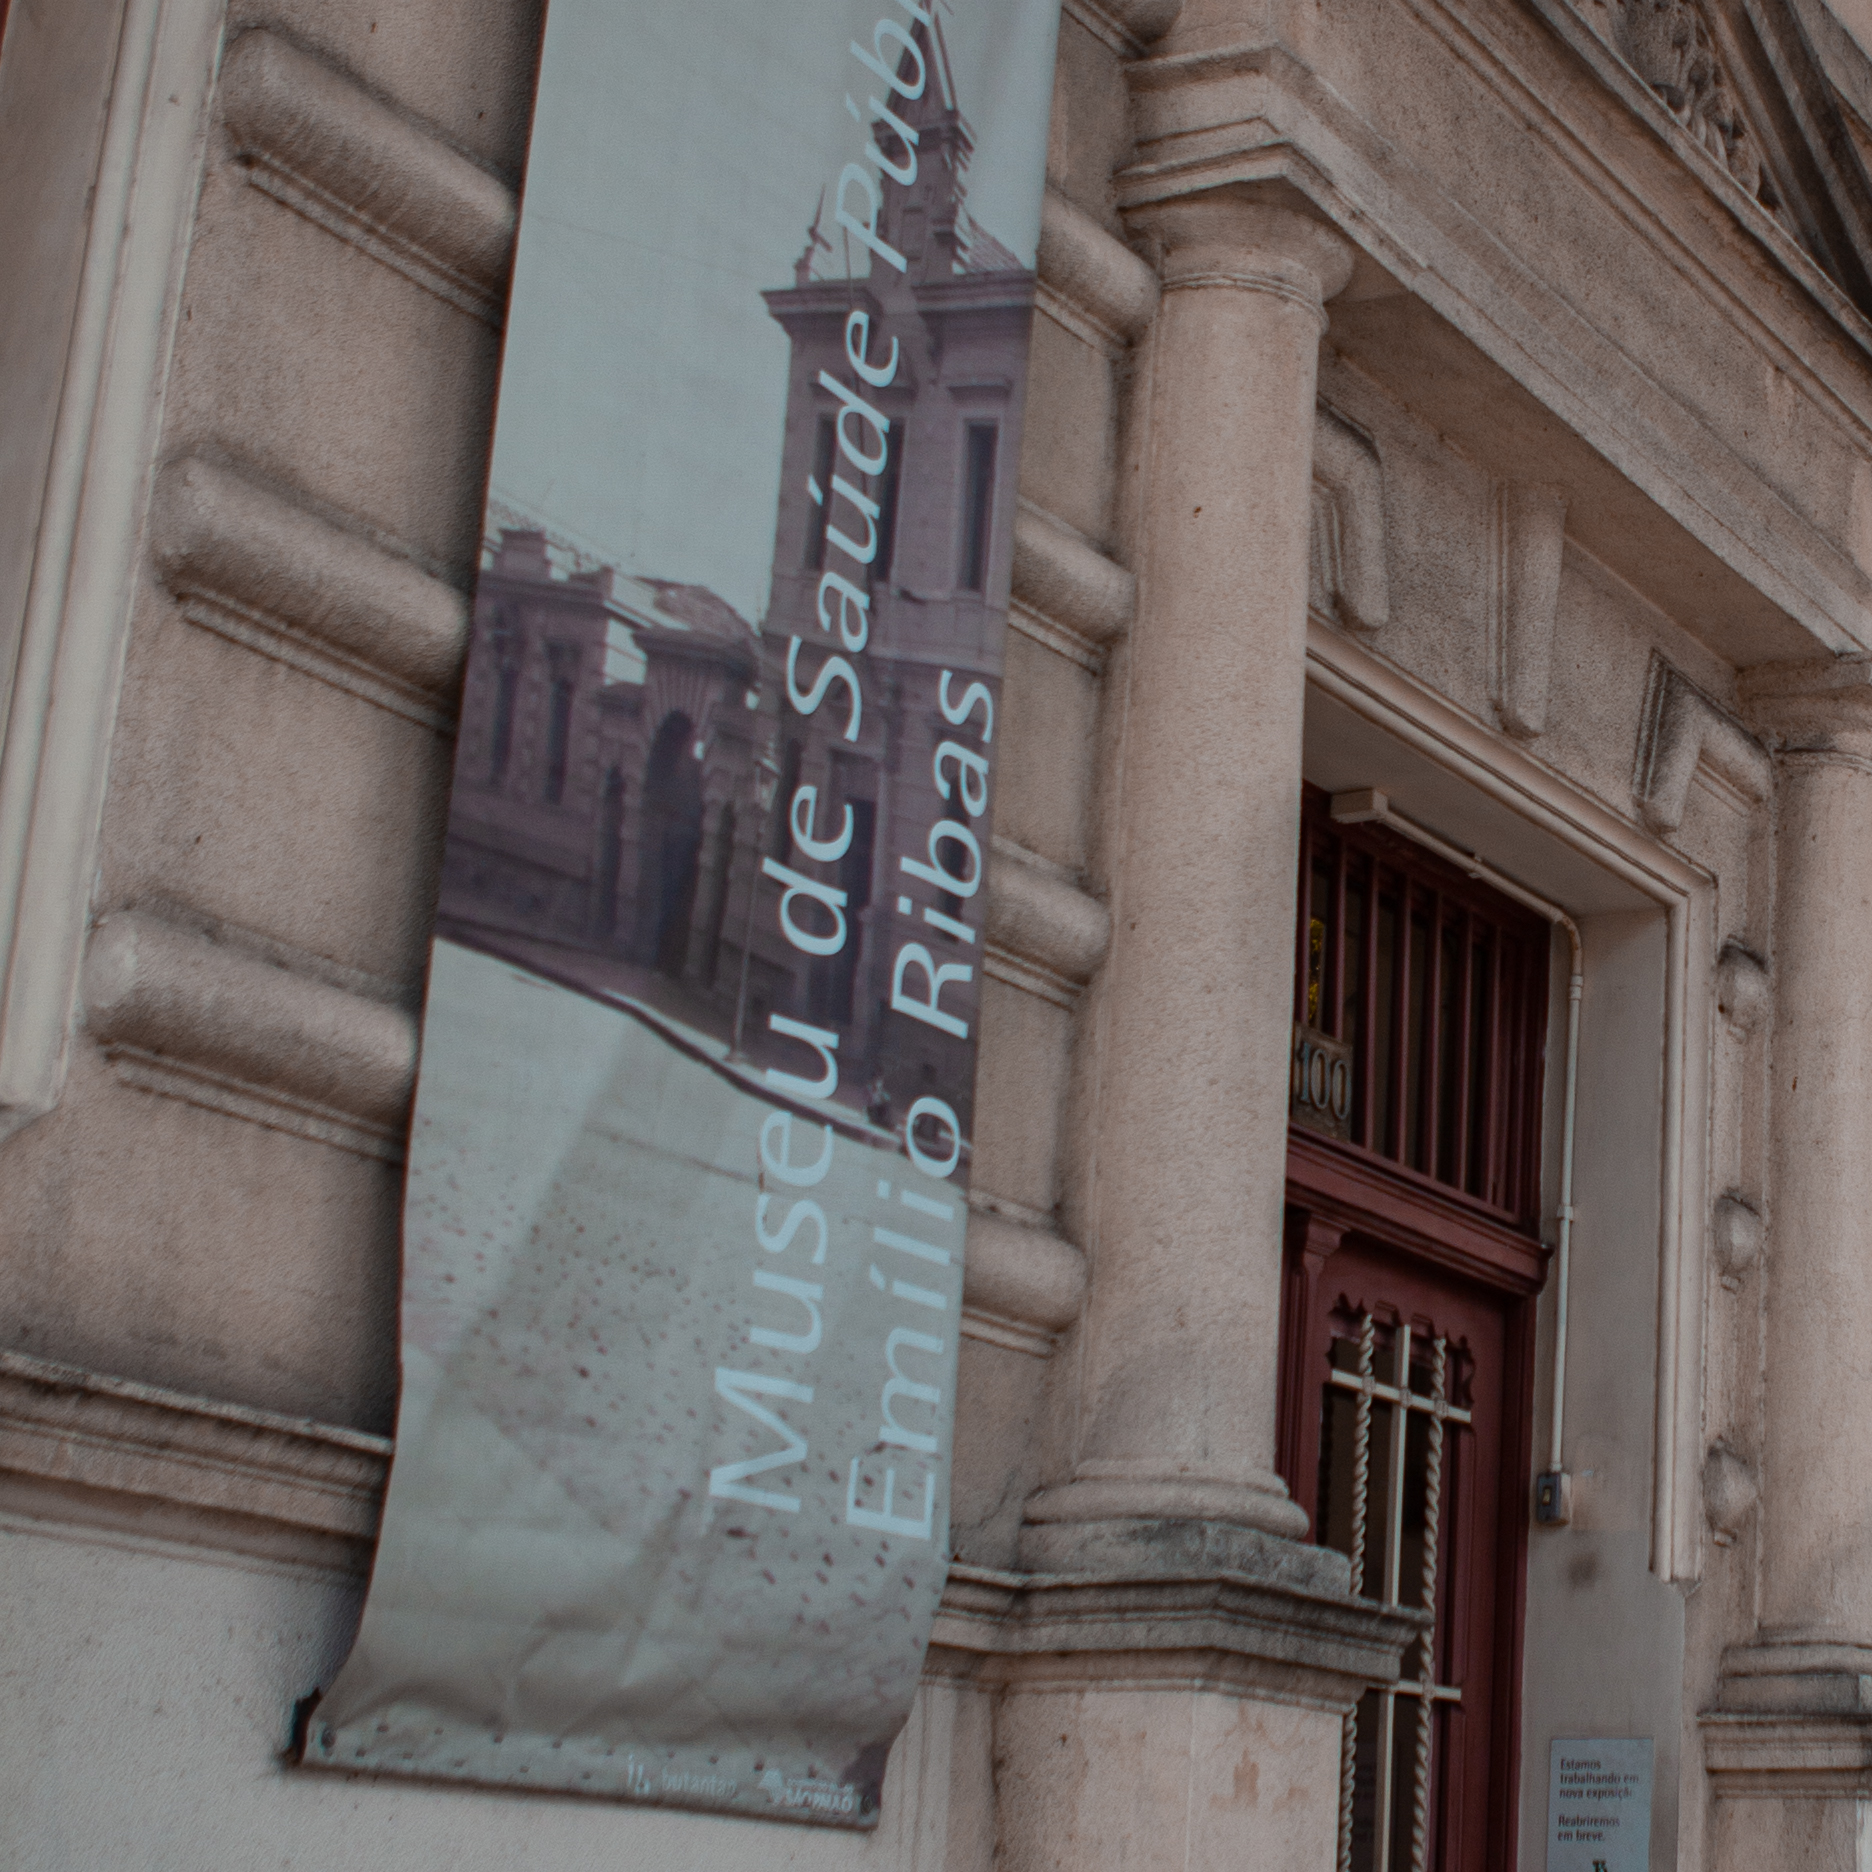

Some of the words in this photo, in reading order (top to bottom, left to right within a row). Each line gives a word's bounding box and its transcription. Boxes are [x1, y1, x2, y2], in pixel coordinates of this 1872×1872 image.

[785, 308, 901, 743] Saúde
[761, 782, 856, 957] de
[890, 668, 995, 1040] Ribas
[1299, 1041, 1352, 1120] 100
[708, 1010, 842, 1513] Museu
[845, 1094, 962, 1541] Emílio
[1559, 1788, 1583, 1799] nova
[1560, 1758, 1601, 1770] Estamos
[1560, 1771, 1621, 1784] trabalhando
[1623, 1773, 1639, 1784] em
[1557, 1830, 1573, 1841] em
[1558, 1814, 1620, 1827] Reabriremos
